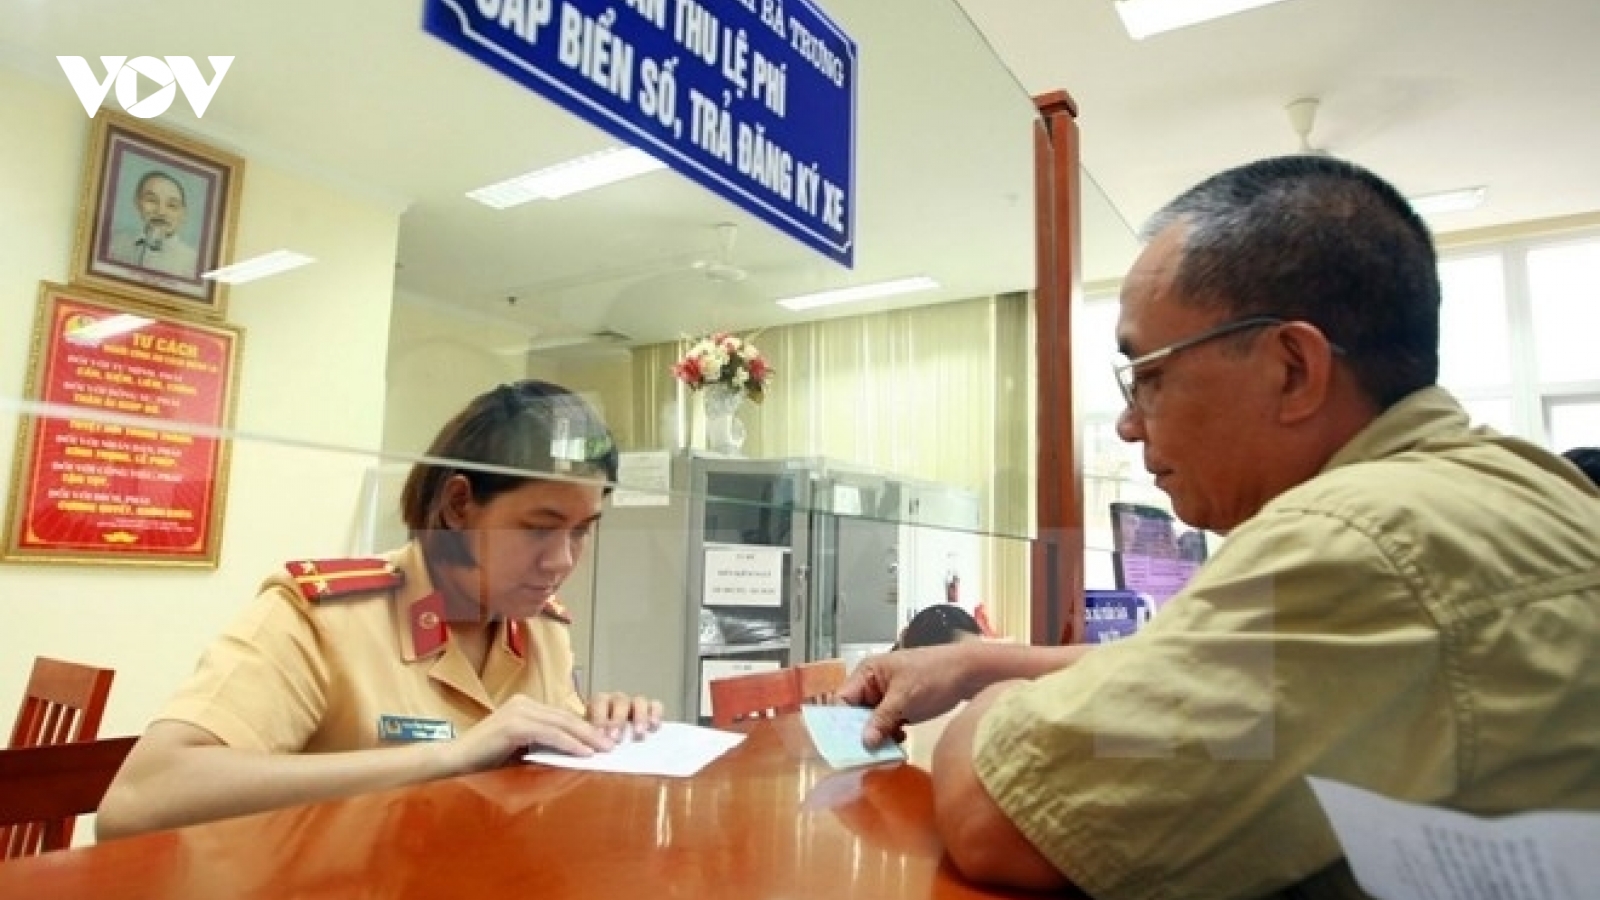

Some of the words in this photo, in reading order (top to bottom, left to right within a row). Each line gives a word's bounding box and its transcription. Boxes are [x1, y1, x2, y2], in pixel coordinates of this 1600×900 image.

[674, 0, 718, 66] THU
[722, 27, 748, 99] LỆ
[752, 51, 787, 118] PHÍ
[789, 16, 844, 88] TRƯNG
[559, 1, 635, 104] BIỂN
[640, 56, 683, 140] SỐ,
[689, 88, 733, 166] TRẢ
[737, 121, 793, 202] ĐĂNG
[795, 161, 820, 217] KÝ
[822, 179, 845, 234] XE
